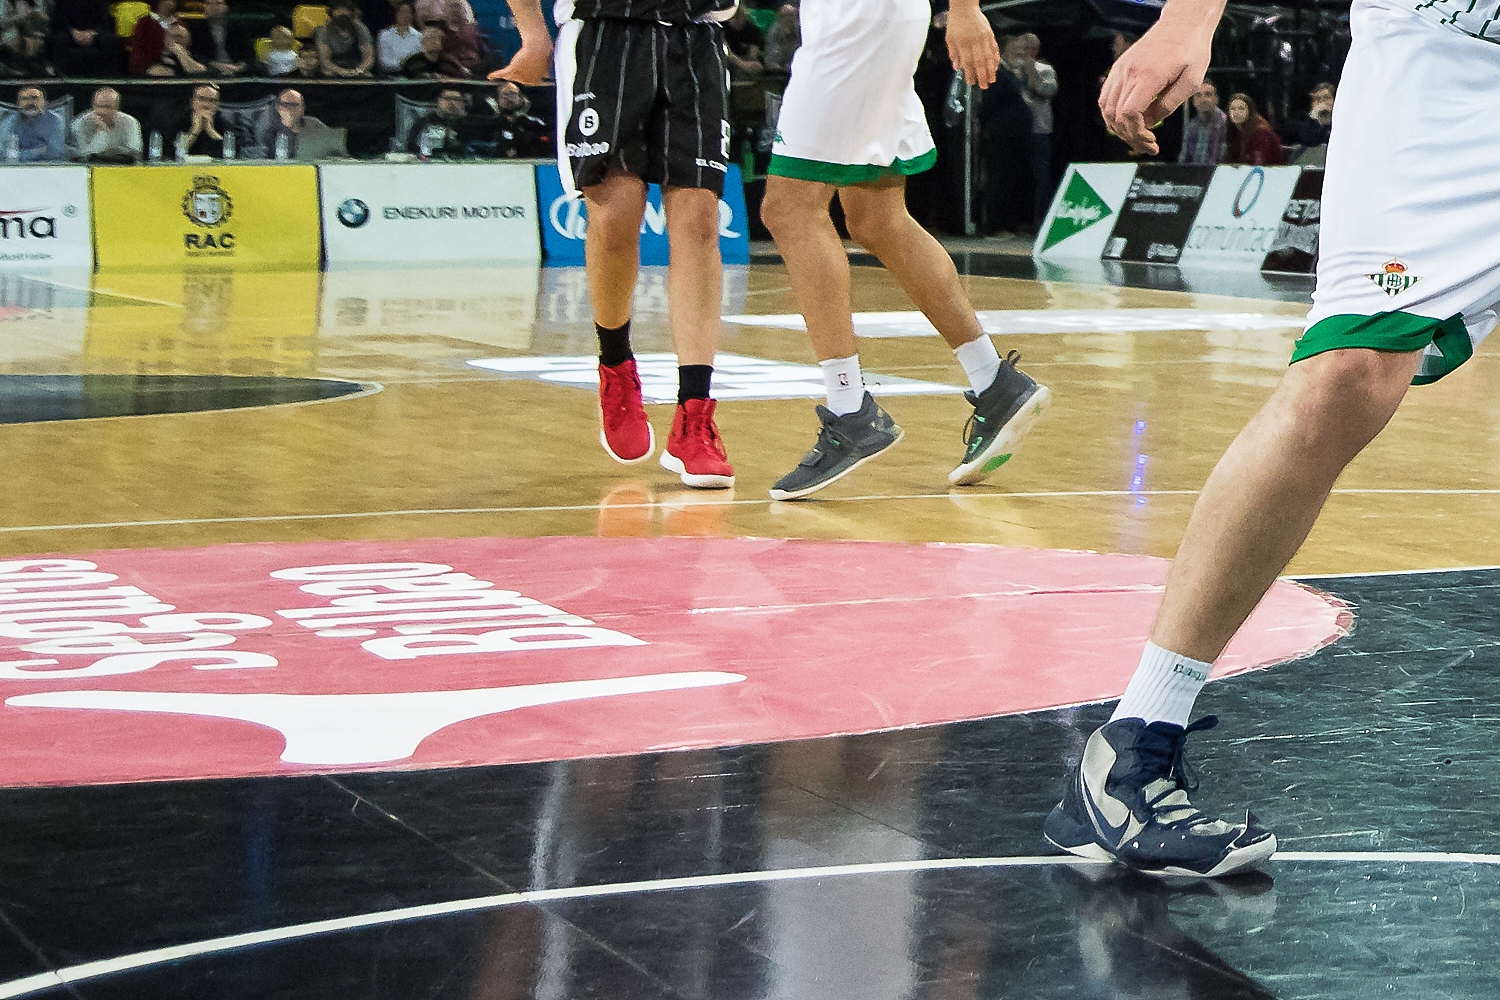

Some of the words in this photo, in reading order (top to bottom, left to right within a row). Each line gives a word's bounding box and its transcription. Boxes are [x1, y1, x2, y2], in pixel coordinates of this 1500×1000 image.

[382, 206, 457, 220] ENEKURI
[461, 205, 526, 219] MOTOR
[183, 233, 237, 249] RAC
[269, 562, 652, 660] Bilbao
